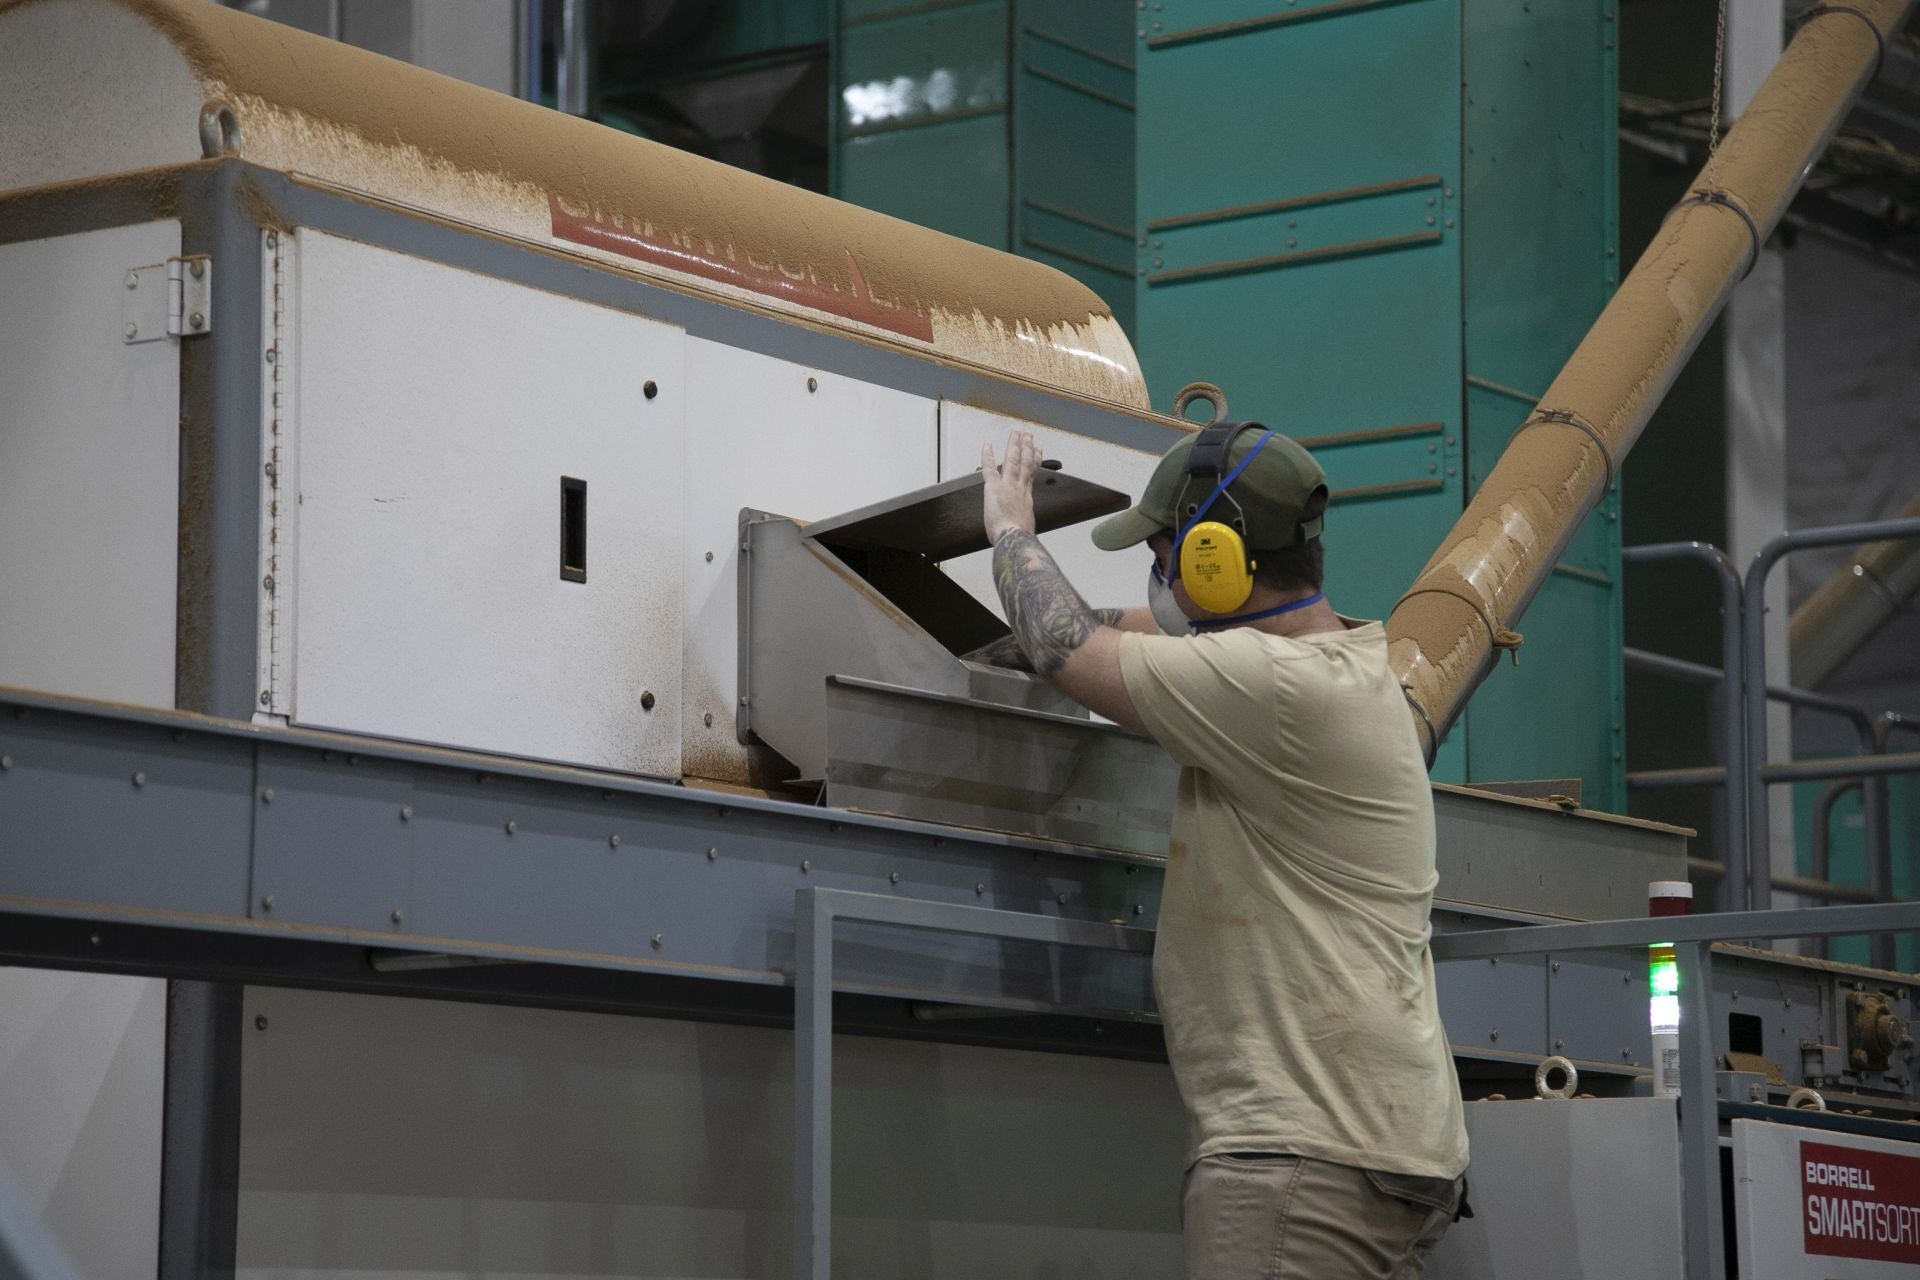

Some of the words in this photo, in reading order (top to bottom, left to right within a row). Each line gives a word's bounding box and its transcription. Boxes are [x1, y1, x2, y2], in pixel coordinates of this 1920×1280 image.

[1200, 538, 1211, 546] 3M
[1806, 1161, 1875, 1191] BORRELL
[1808, 1194, 1920, 1246] SMARTSORT
